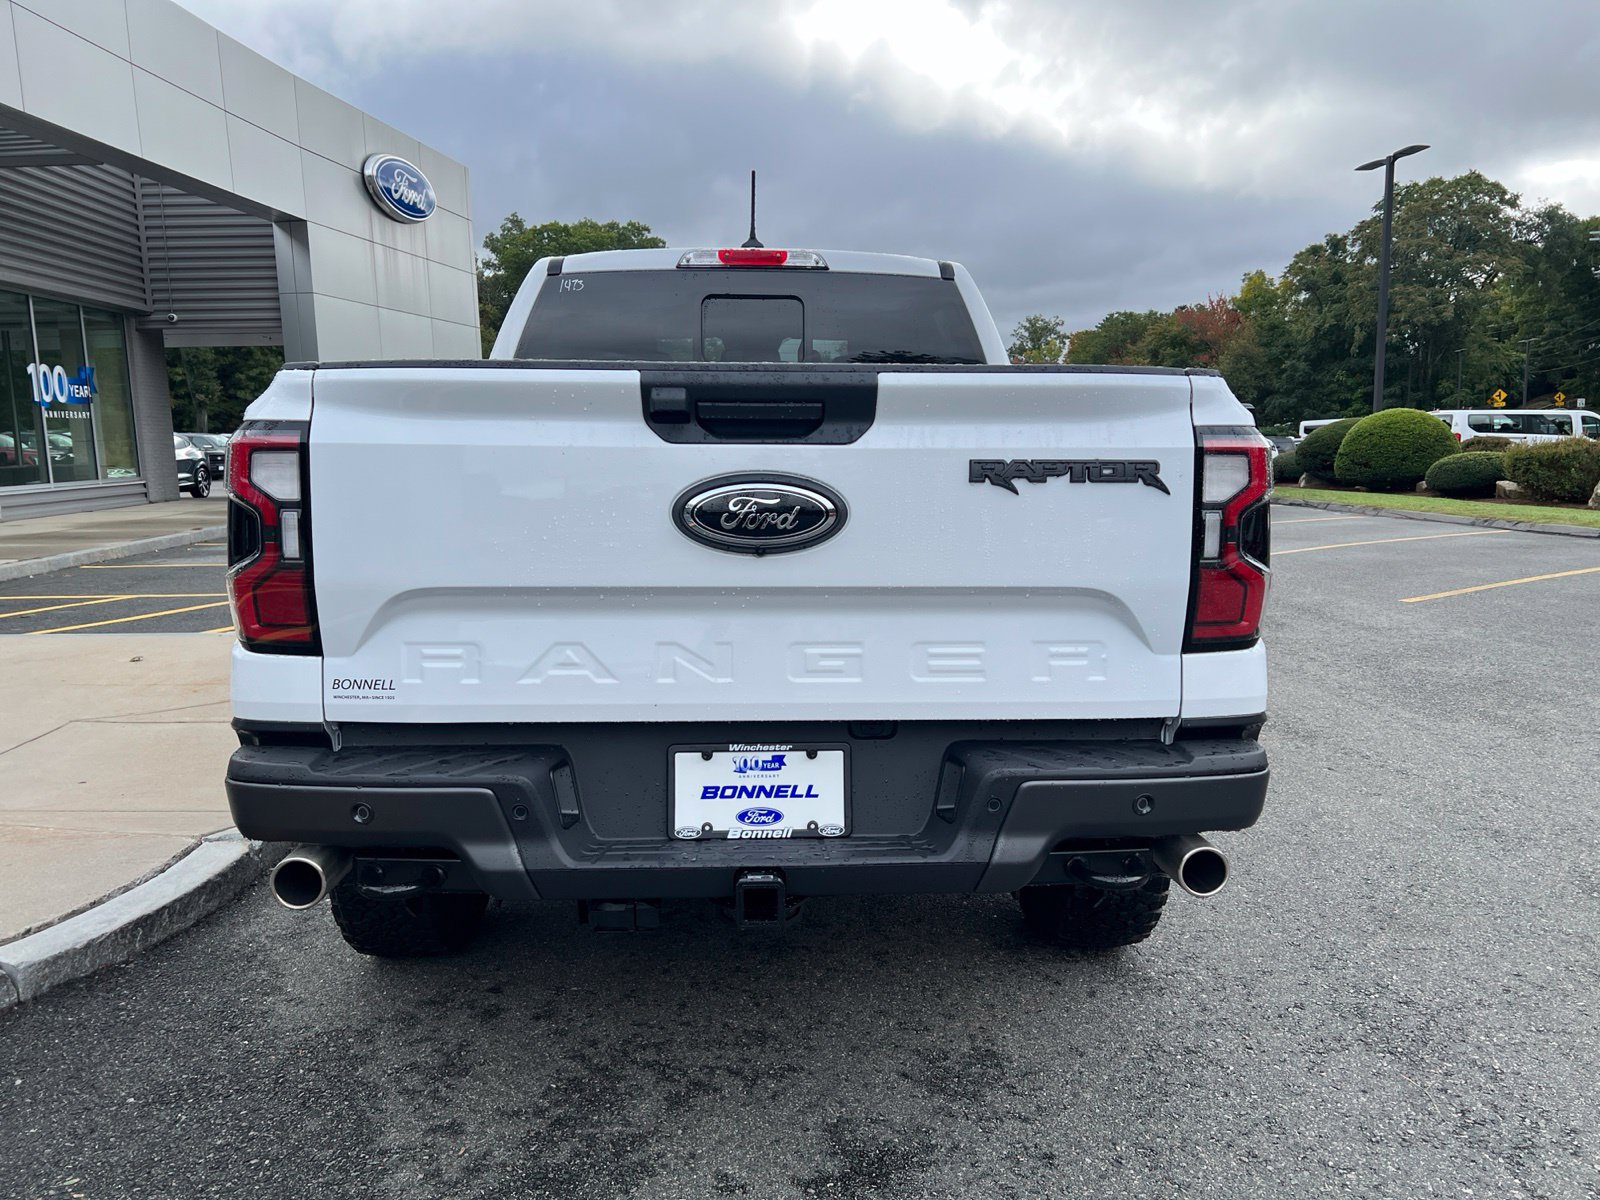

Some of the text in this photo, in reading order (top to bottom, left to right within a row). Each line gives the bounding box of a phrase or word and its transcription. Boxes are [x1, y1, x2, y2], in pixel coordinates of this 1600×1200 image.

[391, 168, 427, 210] Ford
[559, 279, 585, 293] 1473
[26, 363, 68, 403] 100
[44, 410, 90, 419] ANNIVERSARY
[969, 459, 1171, 496] RAPTOR
[720, 496, 800, 530] Ford
[402, 640, 1108, 685] RANGER
[332, 678, 396, 691] BONNELL
[728, 743, 793, 752] Winchester
[732, 755, 762, 772] 100
[700, 784, 819, 800] BONNELL
[744, 808, 775, 824] Ford
[678, 829, 698, 839] Ford
[726, 827, 793, 840] Bonnell
[822, 826, 842, 837] Ford
